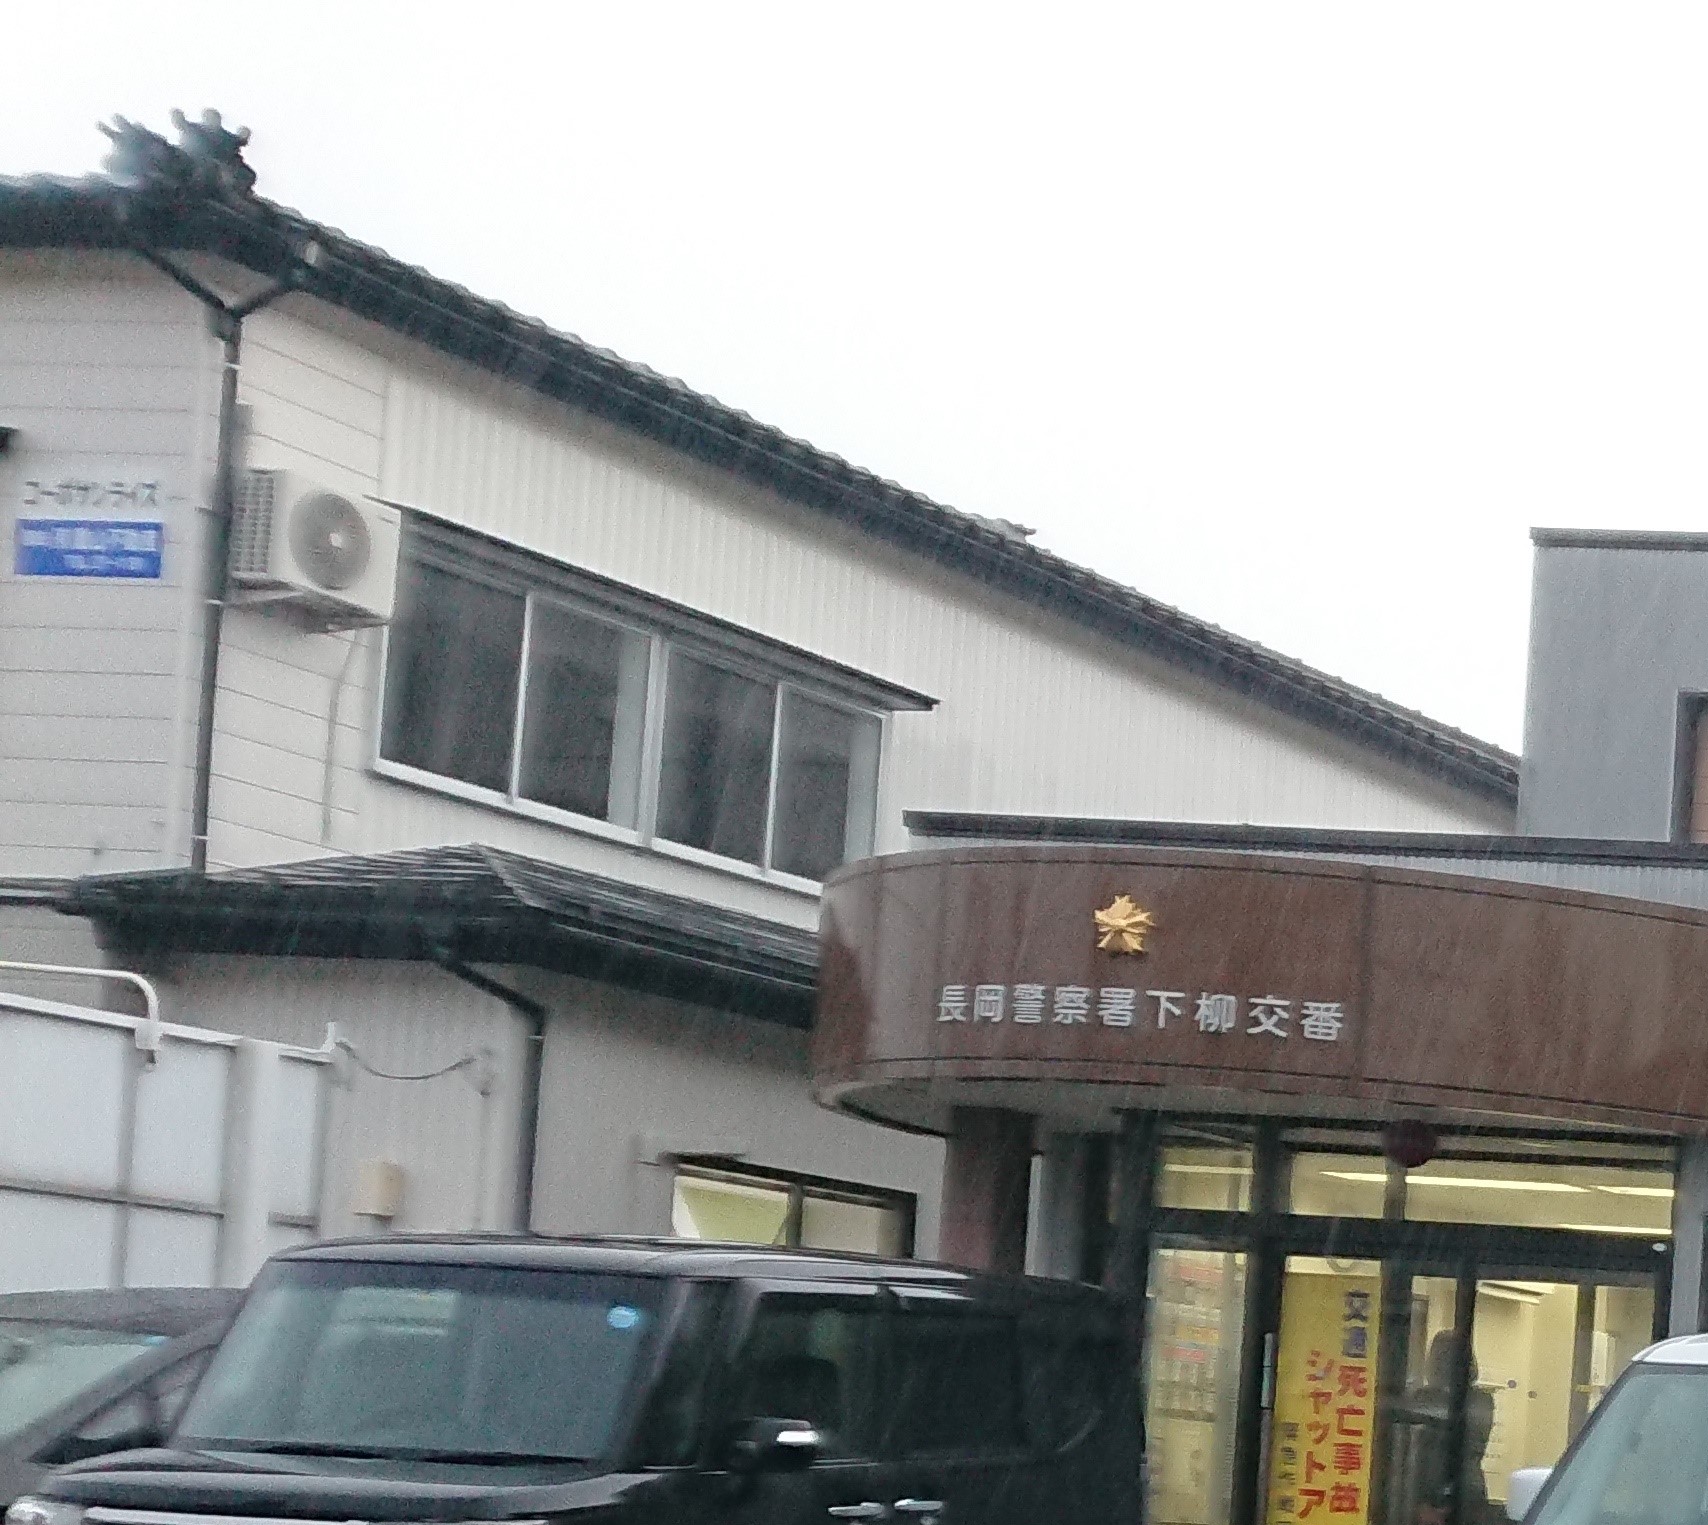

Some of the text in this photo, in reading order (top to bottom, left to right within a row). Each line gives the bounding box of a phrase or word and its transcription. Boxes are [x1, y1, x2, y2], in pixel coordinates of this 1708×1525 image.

[936, 983, 1345, 1042] 長岡警察署下柳交番
